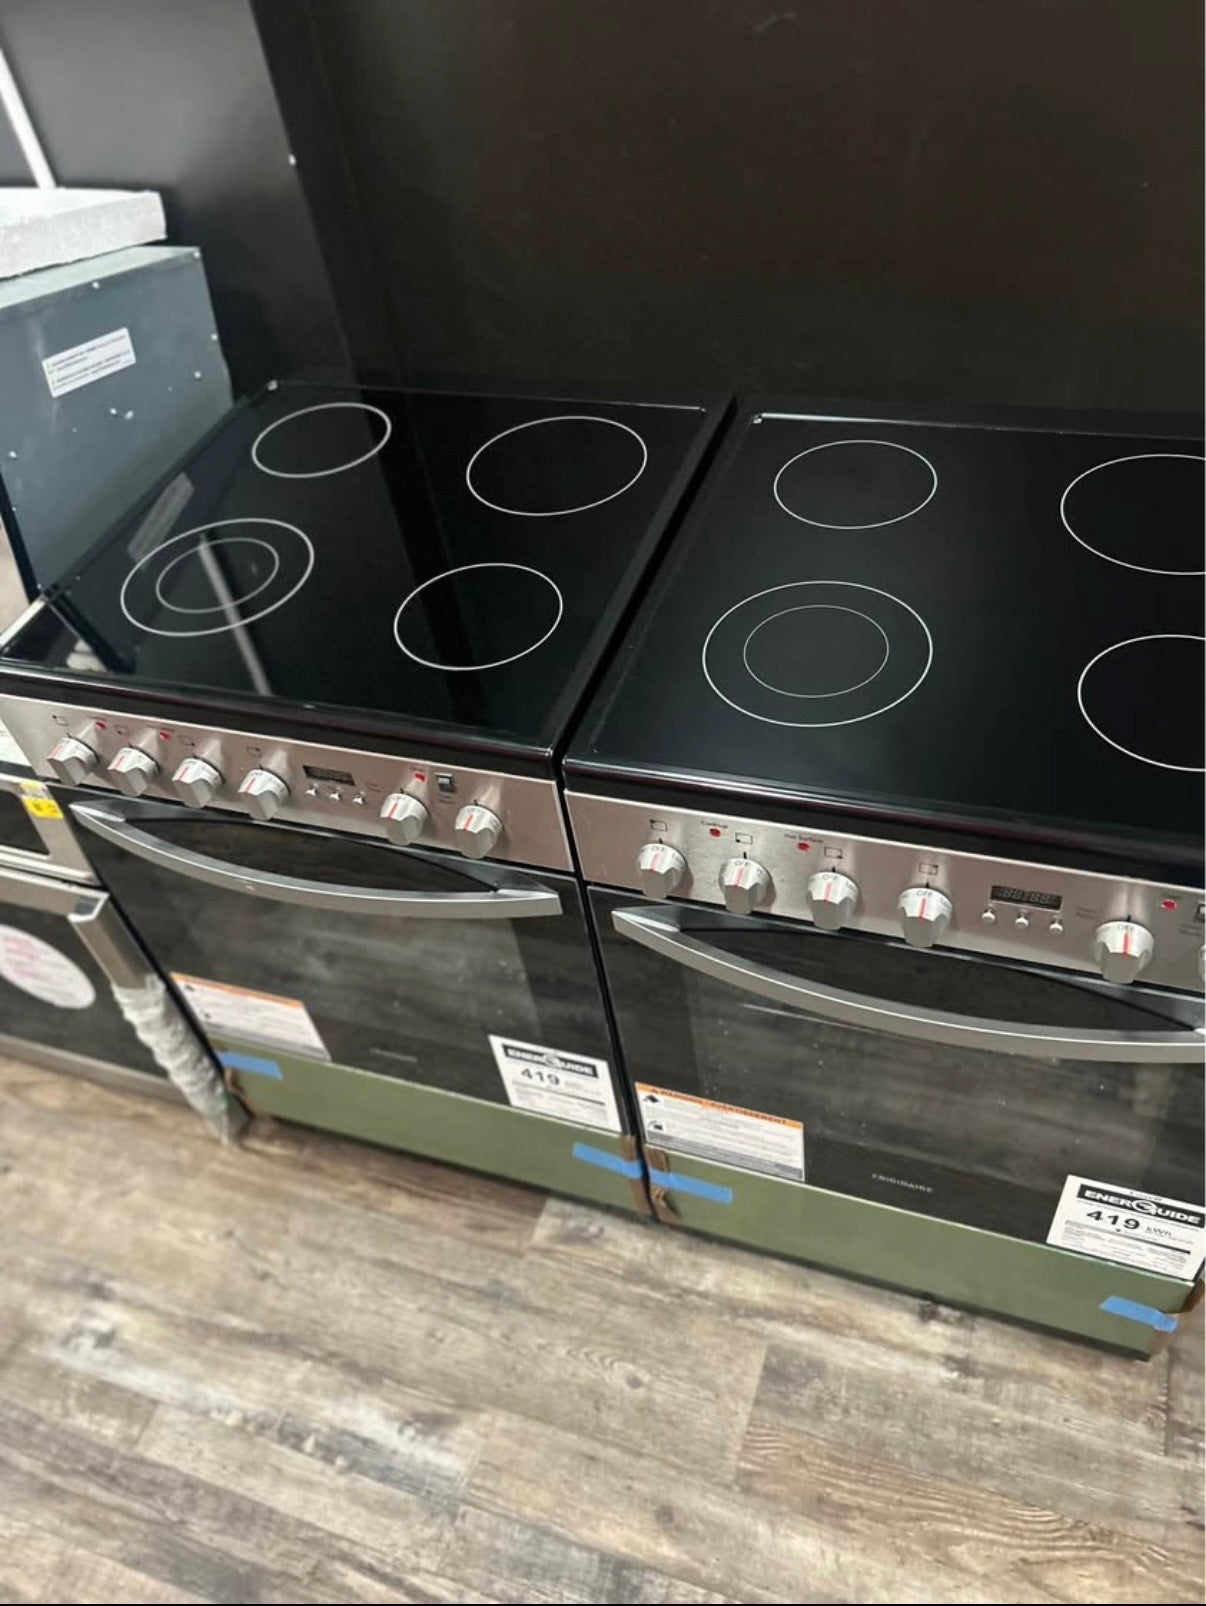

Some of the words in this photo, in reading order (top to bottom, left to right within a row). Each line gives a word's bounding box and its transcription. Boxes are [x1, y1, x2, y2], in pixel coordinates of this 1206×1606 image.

[520, 1067, 561, 1086] 419
[871, 1173, 933, 1193] FRIGIDAIRE
[1083, 1188, 1201, 1225] ENERGUIDE
[1086, 1210, 1141, 1231] 419
